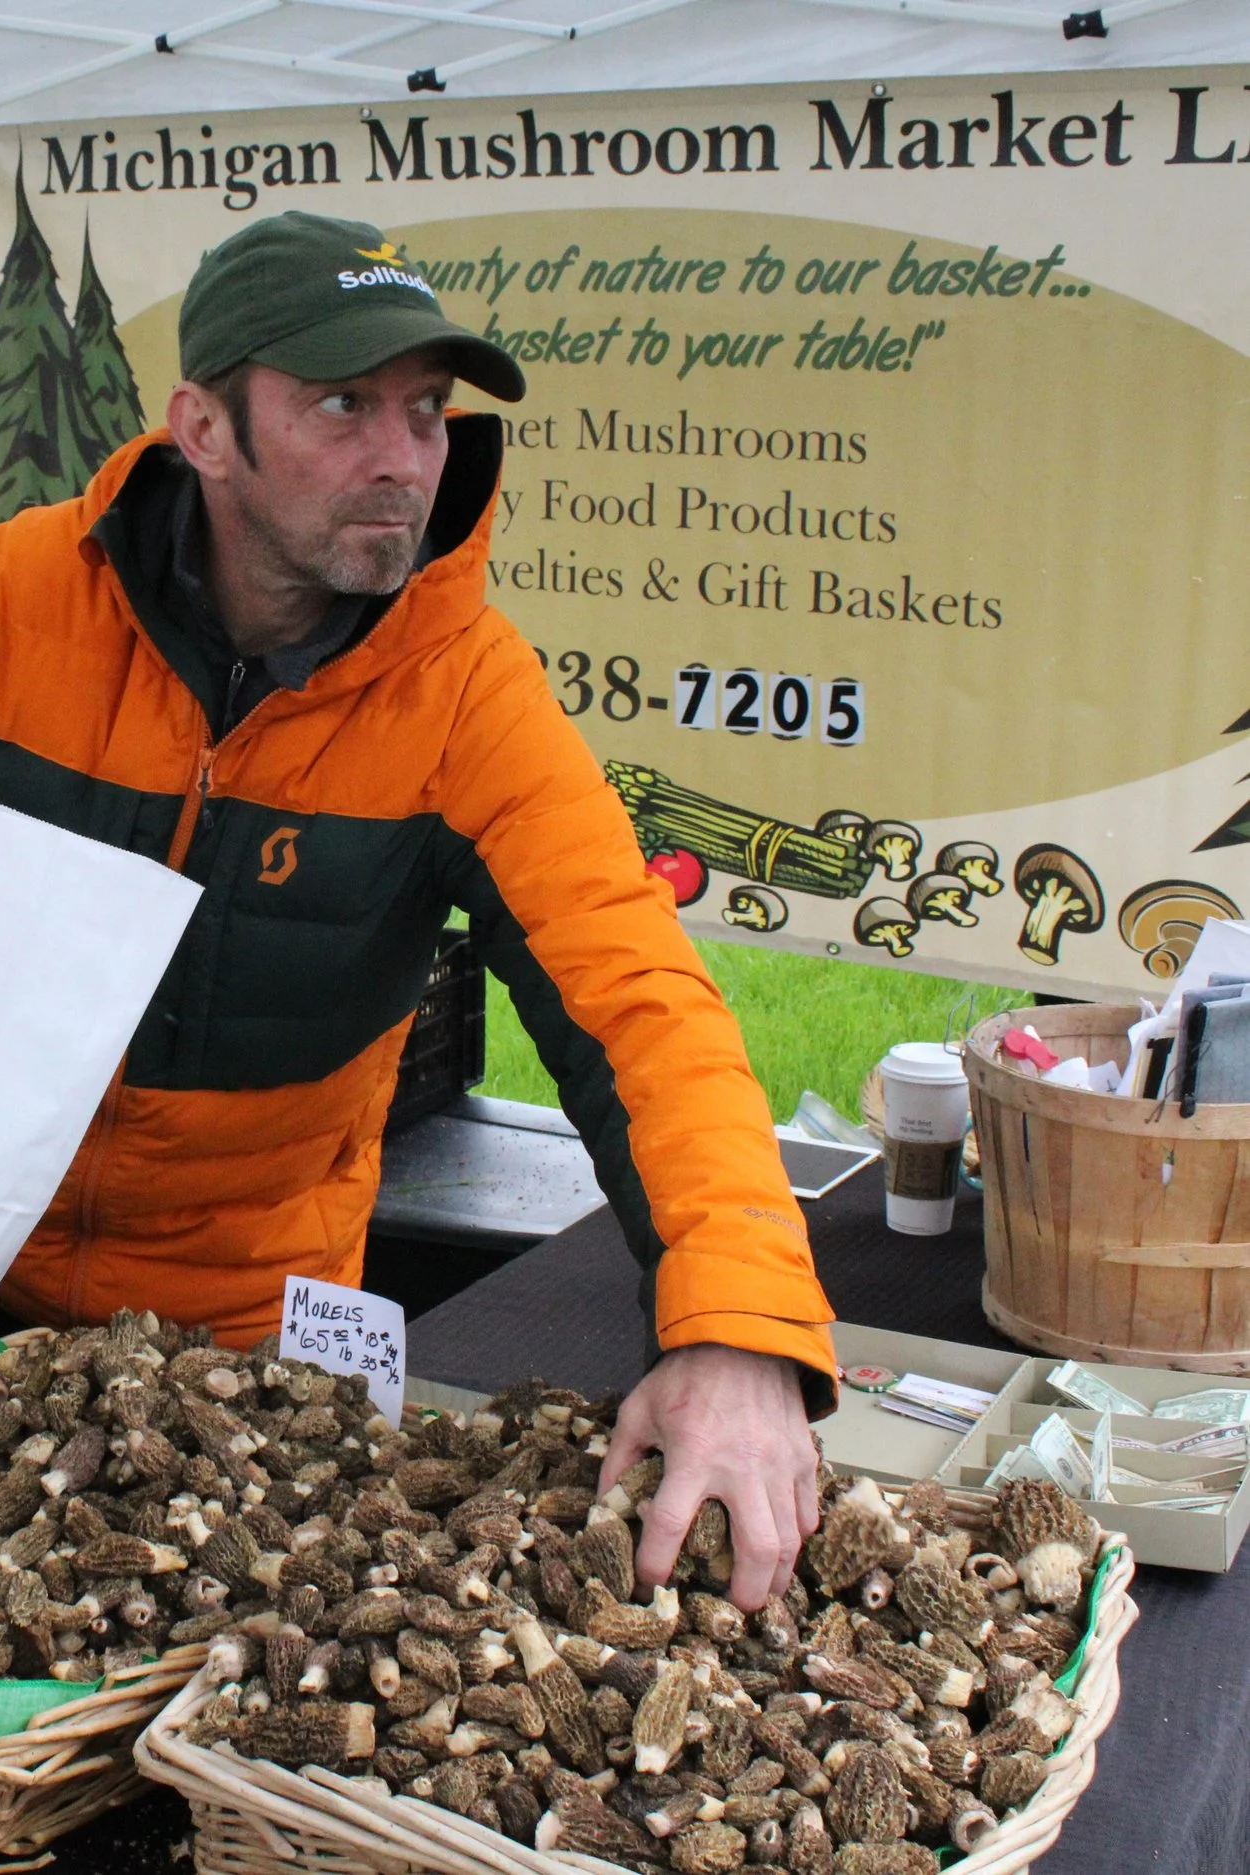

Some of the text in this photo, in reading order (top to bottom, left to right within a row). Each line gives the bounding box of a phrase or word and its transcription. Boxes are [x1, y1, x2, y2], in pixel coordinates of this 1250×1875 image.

[40, 85, 1250, 211] Michigan Mushroom Market L
[525, 244, 580, 293] of
[578, 245, 726, 293] nature
[738, 244, 786, 295] to
[795, 257, 881, 296] our
[887, 240, 1090, 298] basket...
[626, 318, 671, 367] to
[677, 333, 785, 381] your
[576, 408, 867, 464] Mushrooms
[541, 479, 657, 527] Food
[675, 486, 897, 543] Products
[643, 557, 679, 602] &
[698, 562, 789, 611] Gift
[807, 570, 1003, 629] Baskets
[291, 1287, 364, 1322] MORELS
